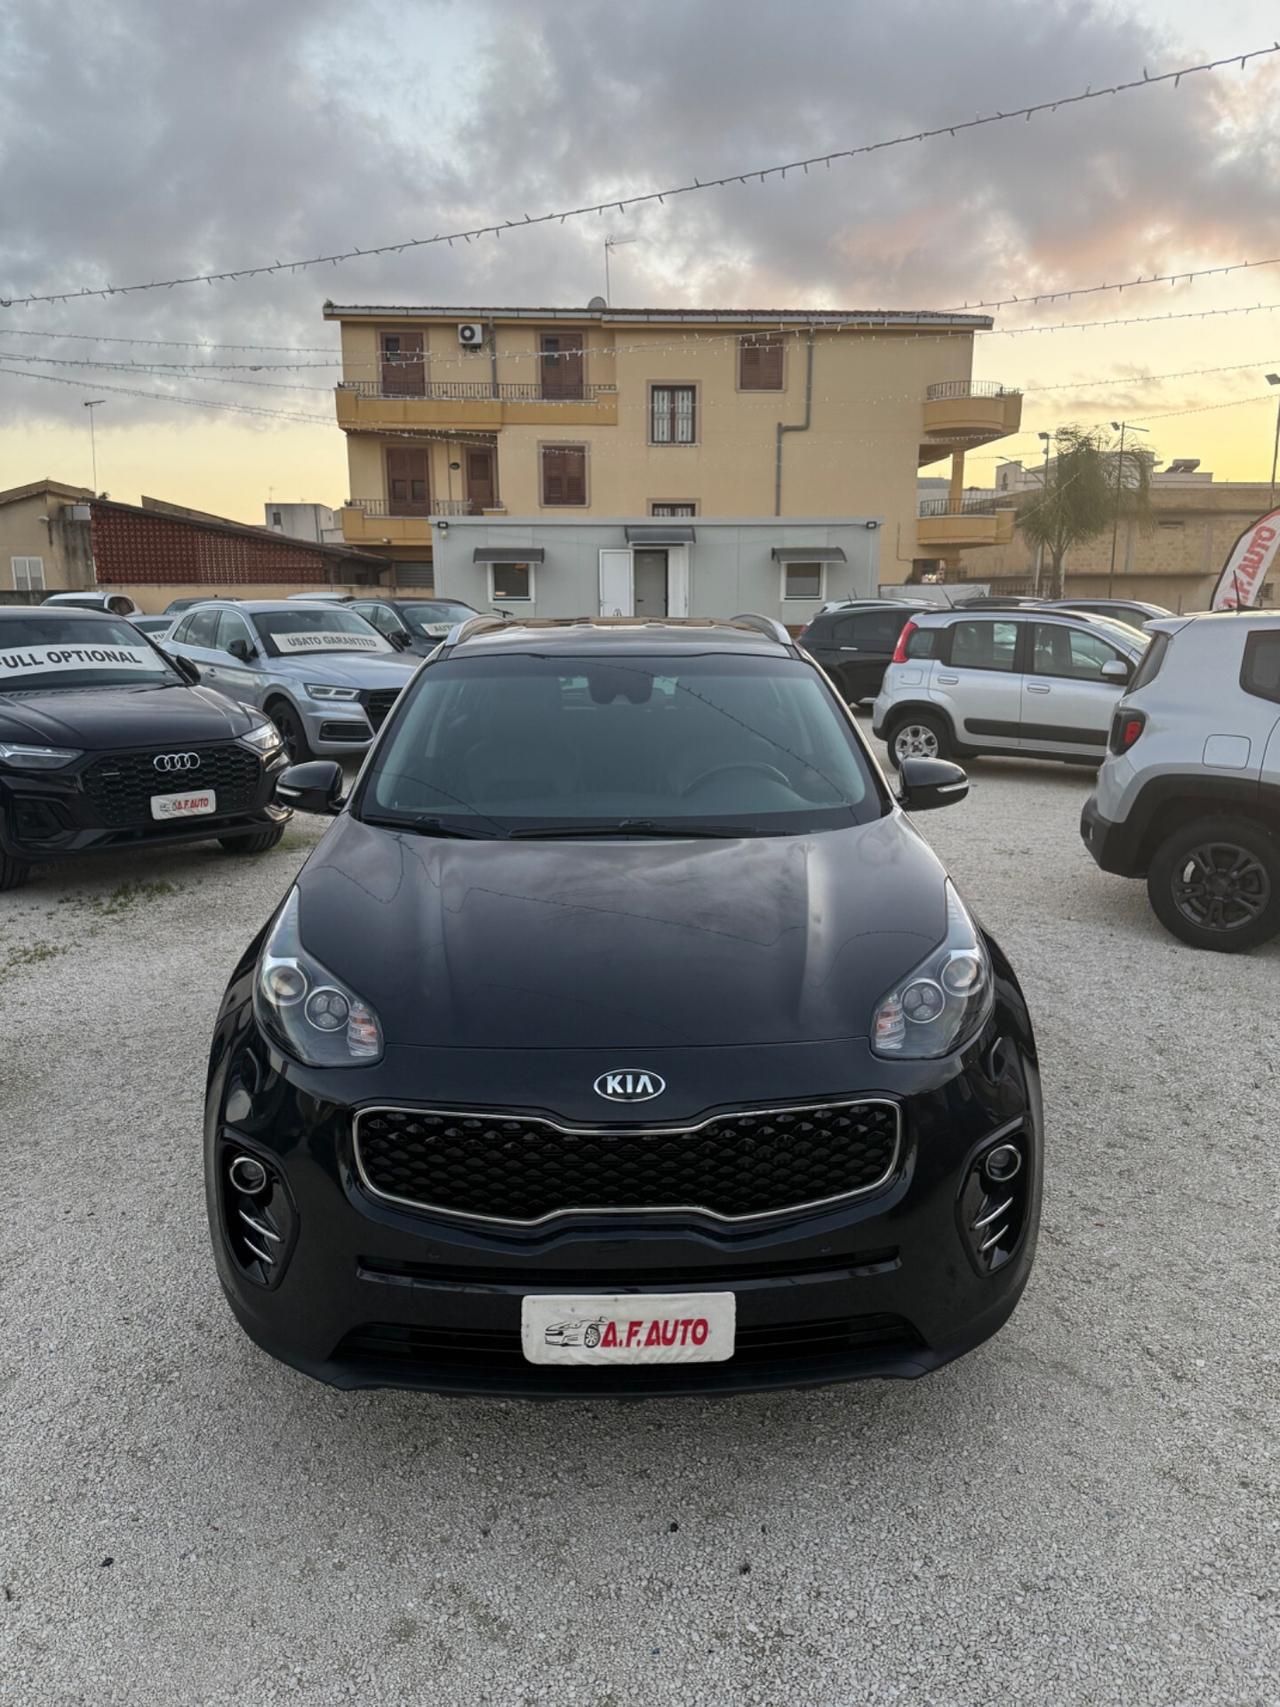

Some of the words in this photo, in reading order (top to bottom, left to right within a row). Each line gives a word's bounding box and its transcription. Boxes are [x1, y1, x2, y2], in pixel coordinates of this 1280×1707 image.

[287, 637, 321, 647] USATO
[322, 636, 376, 647] GARANTITO
[46, 650, 143, 664] OPTIONAL
[606, 1074, 654, 1094] KIA
[600, 1318, 709, 1348] A.F.AUTO
